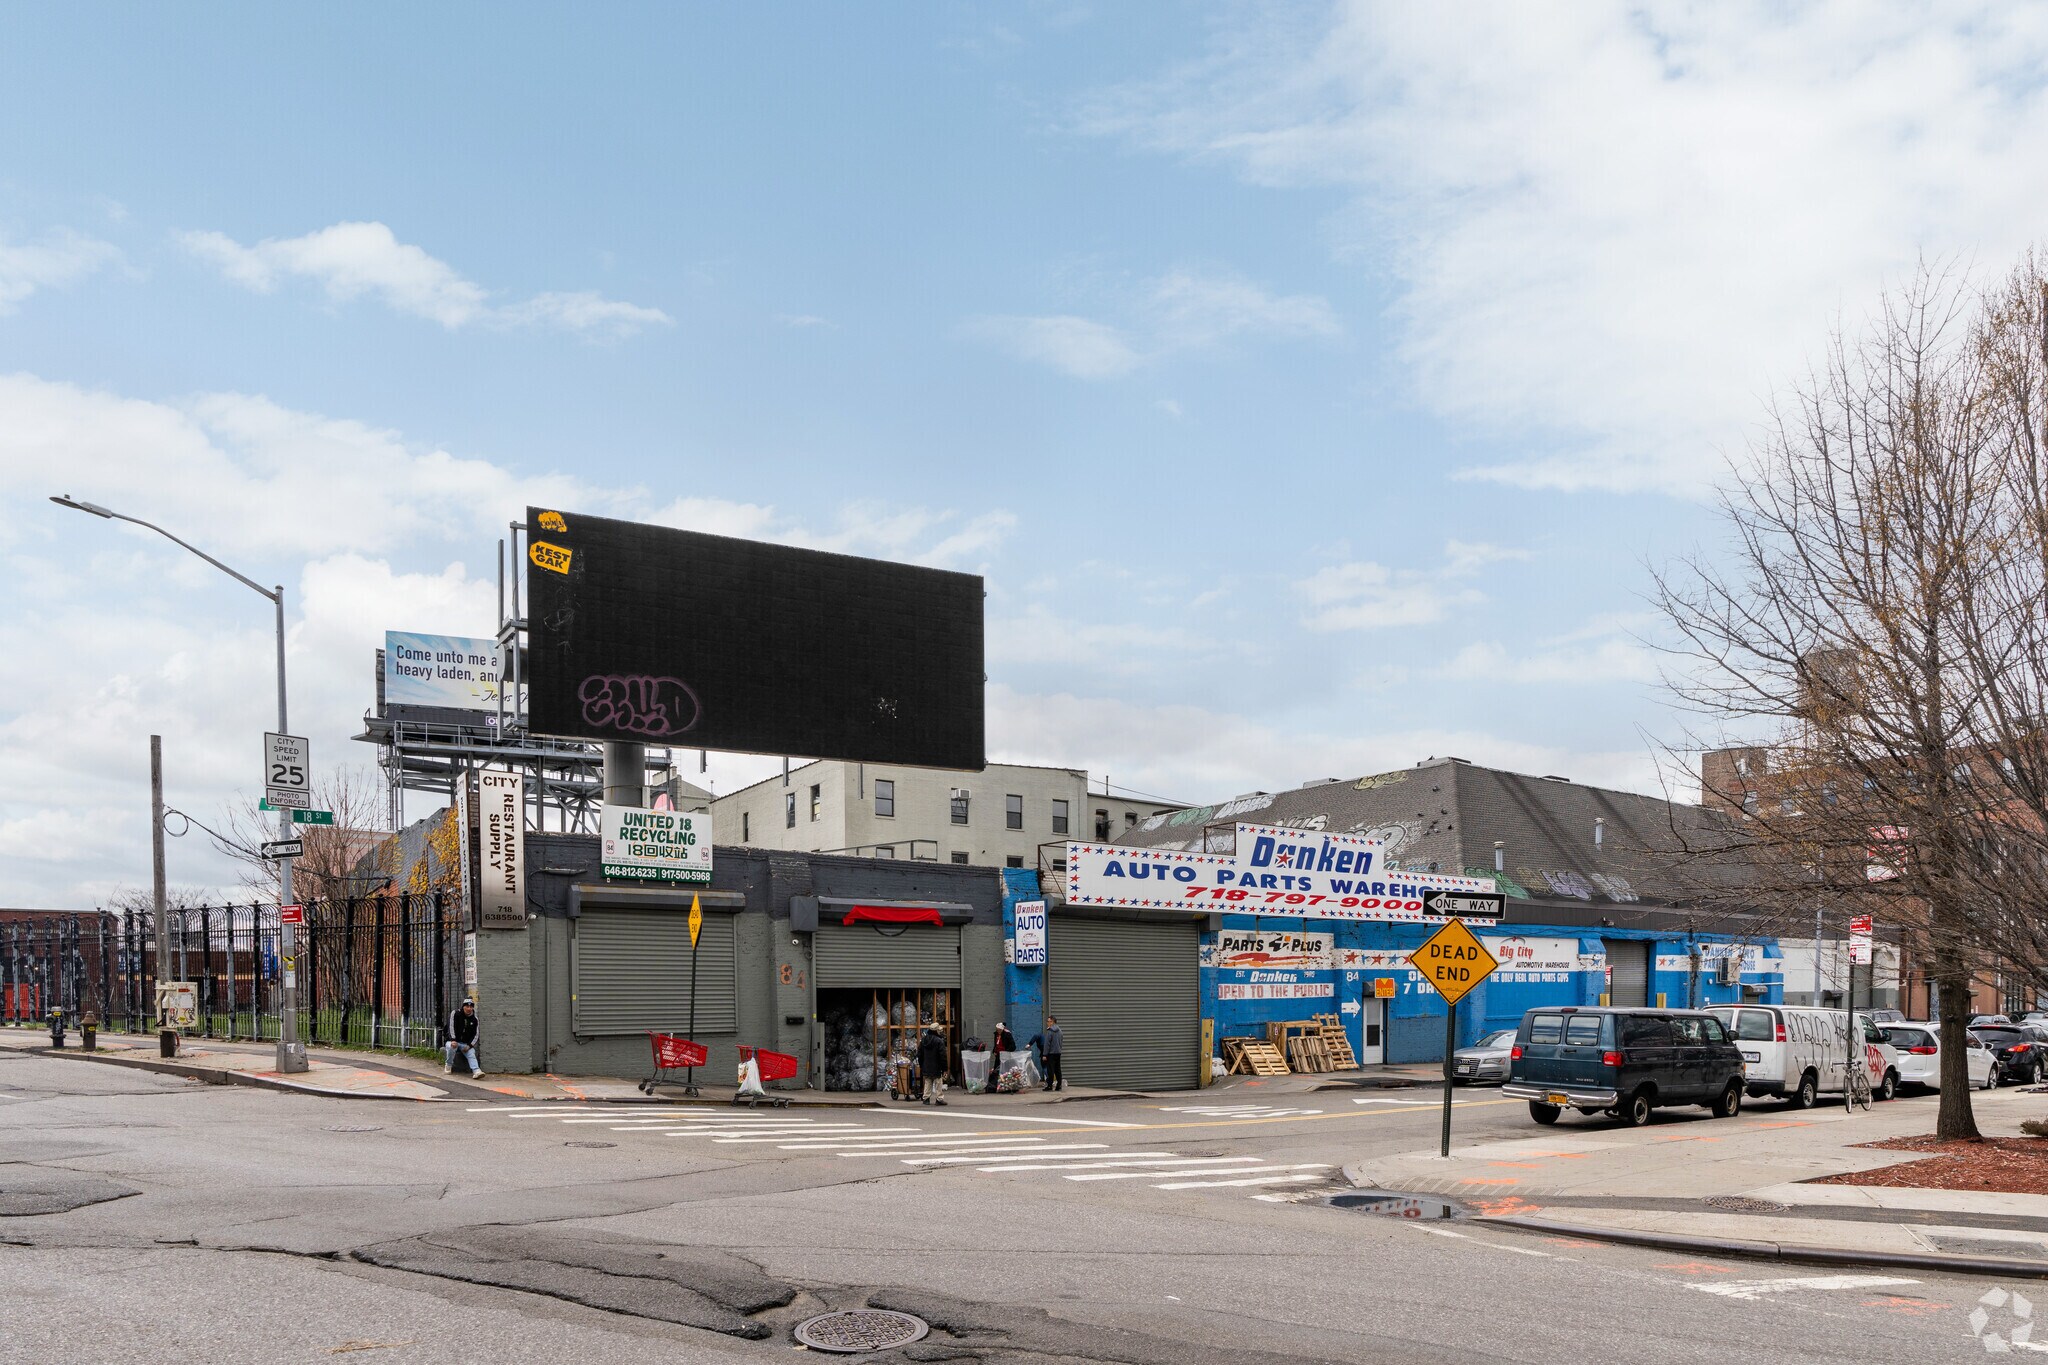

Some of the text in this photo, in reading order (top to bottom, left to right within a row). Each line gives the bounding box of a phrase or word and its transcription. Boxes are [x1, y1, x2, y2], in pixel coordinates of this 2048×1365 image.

[535, 545, 570, 562] KEST
[535, 554, 564, 569] GAK
[396, 645, 431, 661] Come
[436, 650, 463, 664] unto
[468, 655, 486, 666] me
[396, 661, 432, 681] heavy
[437, 665, 475, 683] laden,
[277, 737, 295, 746] CITY
[273, 746, 299, 755] SPEED
[276, 754, 297, 763] LIMIT
[271, 764, 304, 786] 25
[483, 776, 519, 789] CITY
[270, 797, 306, 806] ENFORCED
[277, 791, 299, 799] PHOTO
[303, 811, 312, 822] 18
[623, 812, 692, 831] UNITED 18
[489, 813, 501, 873] SUPPLY
[620, 827, 696, 845] RECYCLING
[266, 844, 299, 856] ONE WAY
[503, 794, 516, 894] RESTAURANT
[628, 844, 688, 859] 18回收站
[604, 866, 711, 881] 646-812-6235 917-500-5968
[1103, 860, 1474, 898] AUTO PARTS WAREHO
[1185, 886, 1422, 911] 718-797-9000
[1435, 898, 1494, 911] ONE WAY
[498, 905, 513, 913] 718
[1017, 915, 1044, 930] AUTO
[1222, 938, 1322, 952] PARTS PLUS
[1430, 944, 1478, 961] DEAD
[1499, 945, 1534, 960] Big City
[1017, 948, 1045, 962] PARTS
[1515, 961, 1543, 969] AUTOMOTIVE
[781, 964, 805, 991] 84
[1346, 971, 1359, 982] 84
[1408, 970, 1425, 982] OP
[1436, 966, 1470, 982] END
[1490, 972, 1500, 982] THE
[1501, 972, 1514, 982] ONLY
[1528, 973, 1540, 982] AUTO
[1541, 972, 1556, 982] PARTS
[1557, 973, 1569, 982] GUYS
[1218, 984, 1330, 999] OPEN TO THE PUBLIC
[1376, 987, 1394, 997] ENTER
[1403, 983, 1411, 994] 7
[1417, 983, 1439, 994] DA
